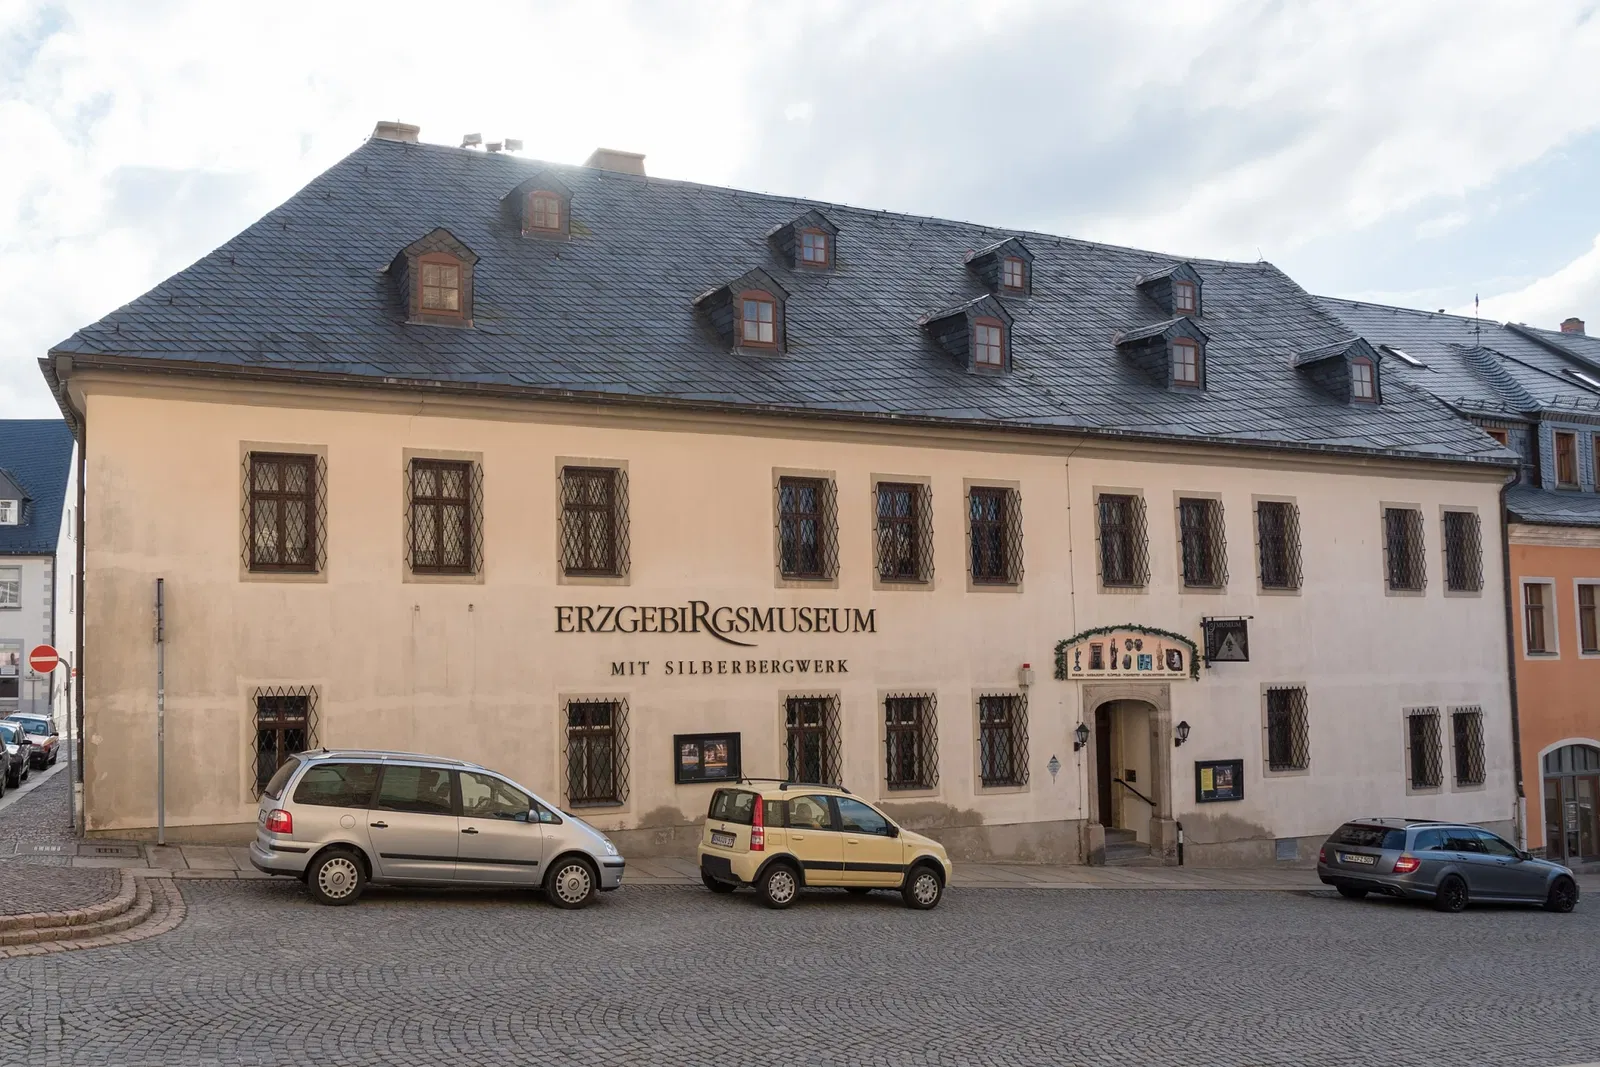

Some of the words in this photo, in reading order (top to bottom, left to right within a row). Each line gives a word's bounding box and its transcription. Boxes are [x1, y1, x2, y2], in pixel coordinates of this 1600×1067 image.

[554, 600, 877, 647] ERZGEBIRGSMUSEUM
[610, 660, 650, 676] MIT
[665, 659, 850, 676] SILBERBERGWERK
